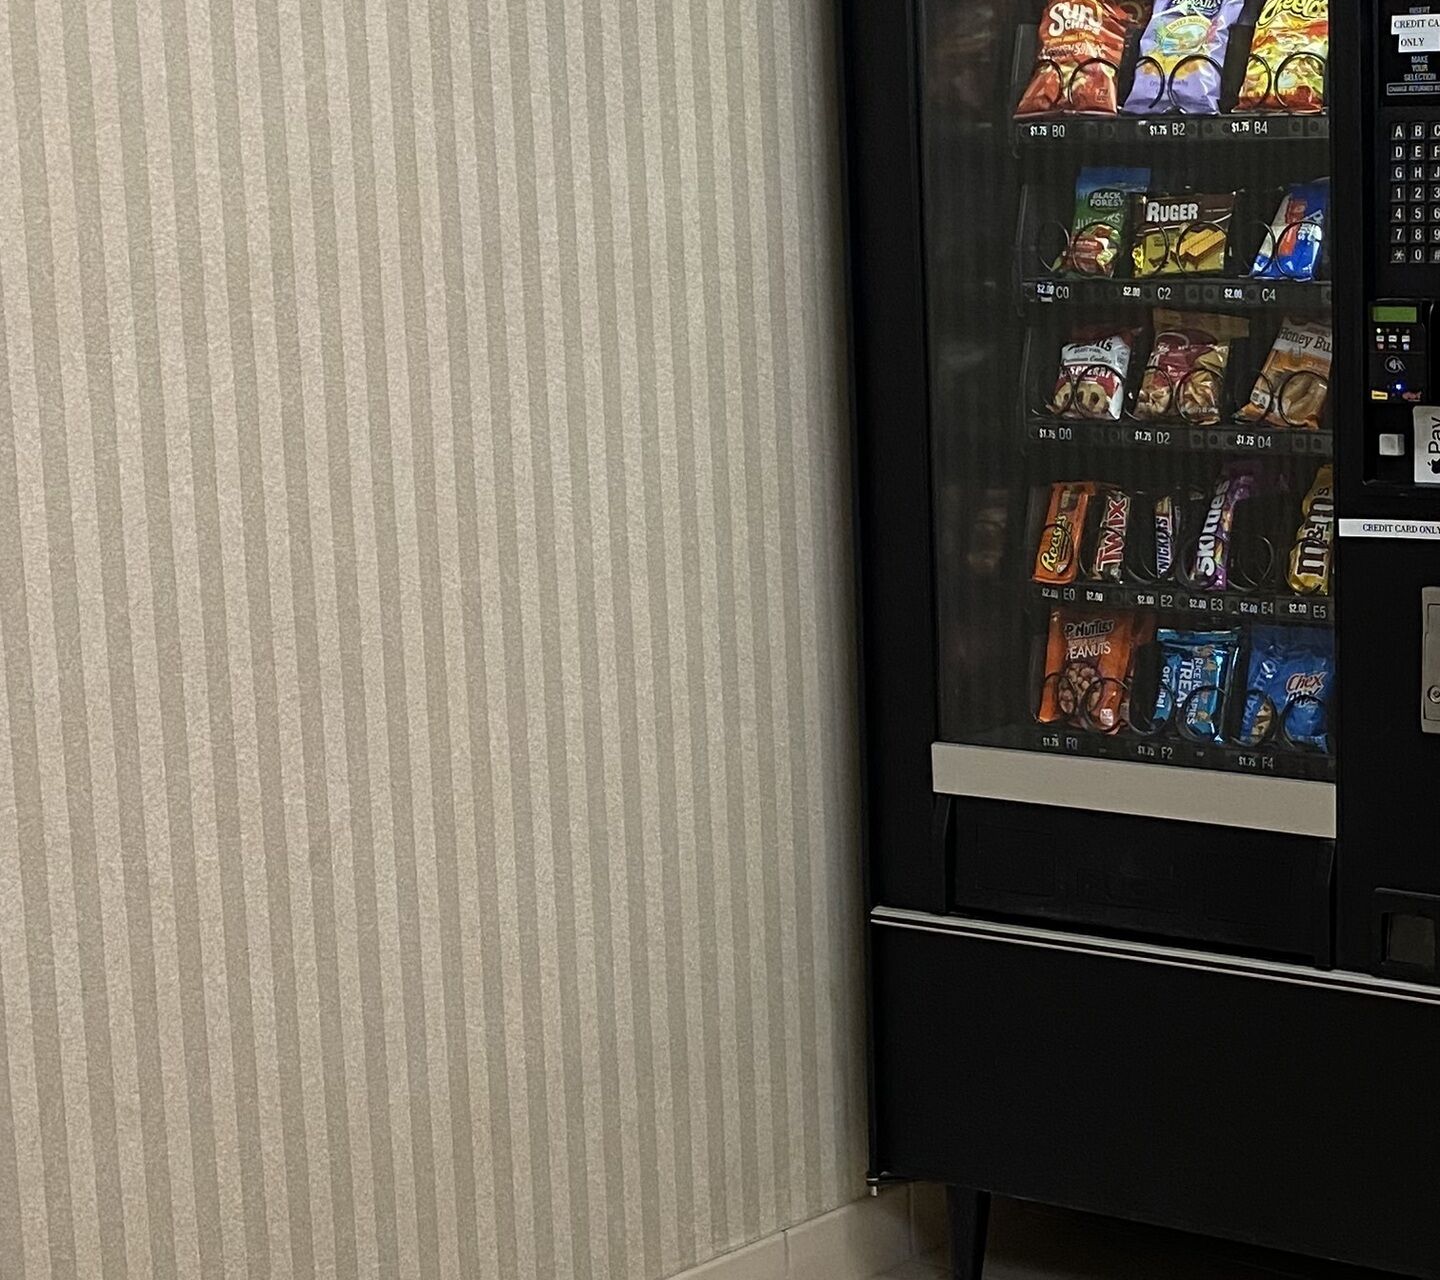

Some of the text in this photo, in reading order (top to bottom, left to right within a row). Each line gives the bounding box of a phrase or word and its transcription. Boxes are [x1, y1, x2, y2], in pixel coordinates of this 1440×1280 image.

[1393, 19, 1427, 29] CREDIT
[1400, 37, 1425, 47] ONLY
[1411, 55, 1429, 64] MAKE
[1411, 64, 1429, 72] YOUR
[1403, 72, 1437, 82] SELECTION
[1030, 125, 1048, 137] $1.75
[1149, 123, 1186, 137] $1.75 B2
[1231, 120, 1268, 134] $1.75 B4
[1146, 202, 1199, 223] RUGER
[1122, 286, 1171, 301] $2.00 C2
[1262, 288, 1277, 302] C4
[1278, 327, 1333, 353] Honey Bu
[1134, 430, 1152, 442] $1.75
[1236, 434, 1254, 447] $1.75
[1095, 497, 1128, 572] TWIX
[1362, 523, 1394, 534] CREDIT
[1394, 524, 1418, 534] CARD
[1160, 594, 1173, 607] E2
[1210, 598, 1223, 611] E3
[1261, 601, 1274, 614] E4
[1288, 603, 1326, 618] $2.00 E5
[1286, 672, 1328, 694] Chex
[1161, 747, 1173, 760] F2
[1261, 757, 1275, 770] F4
